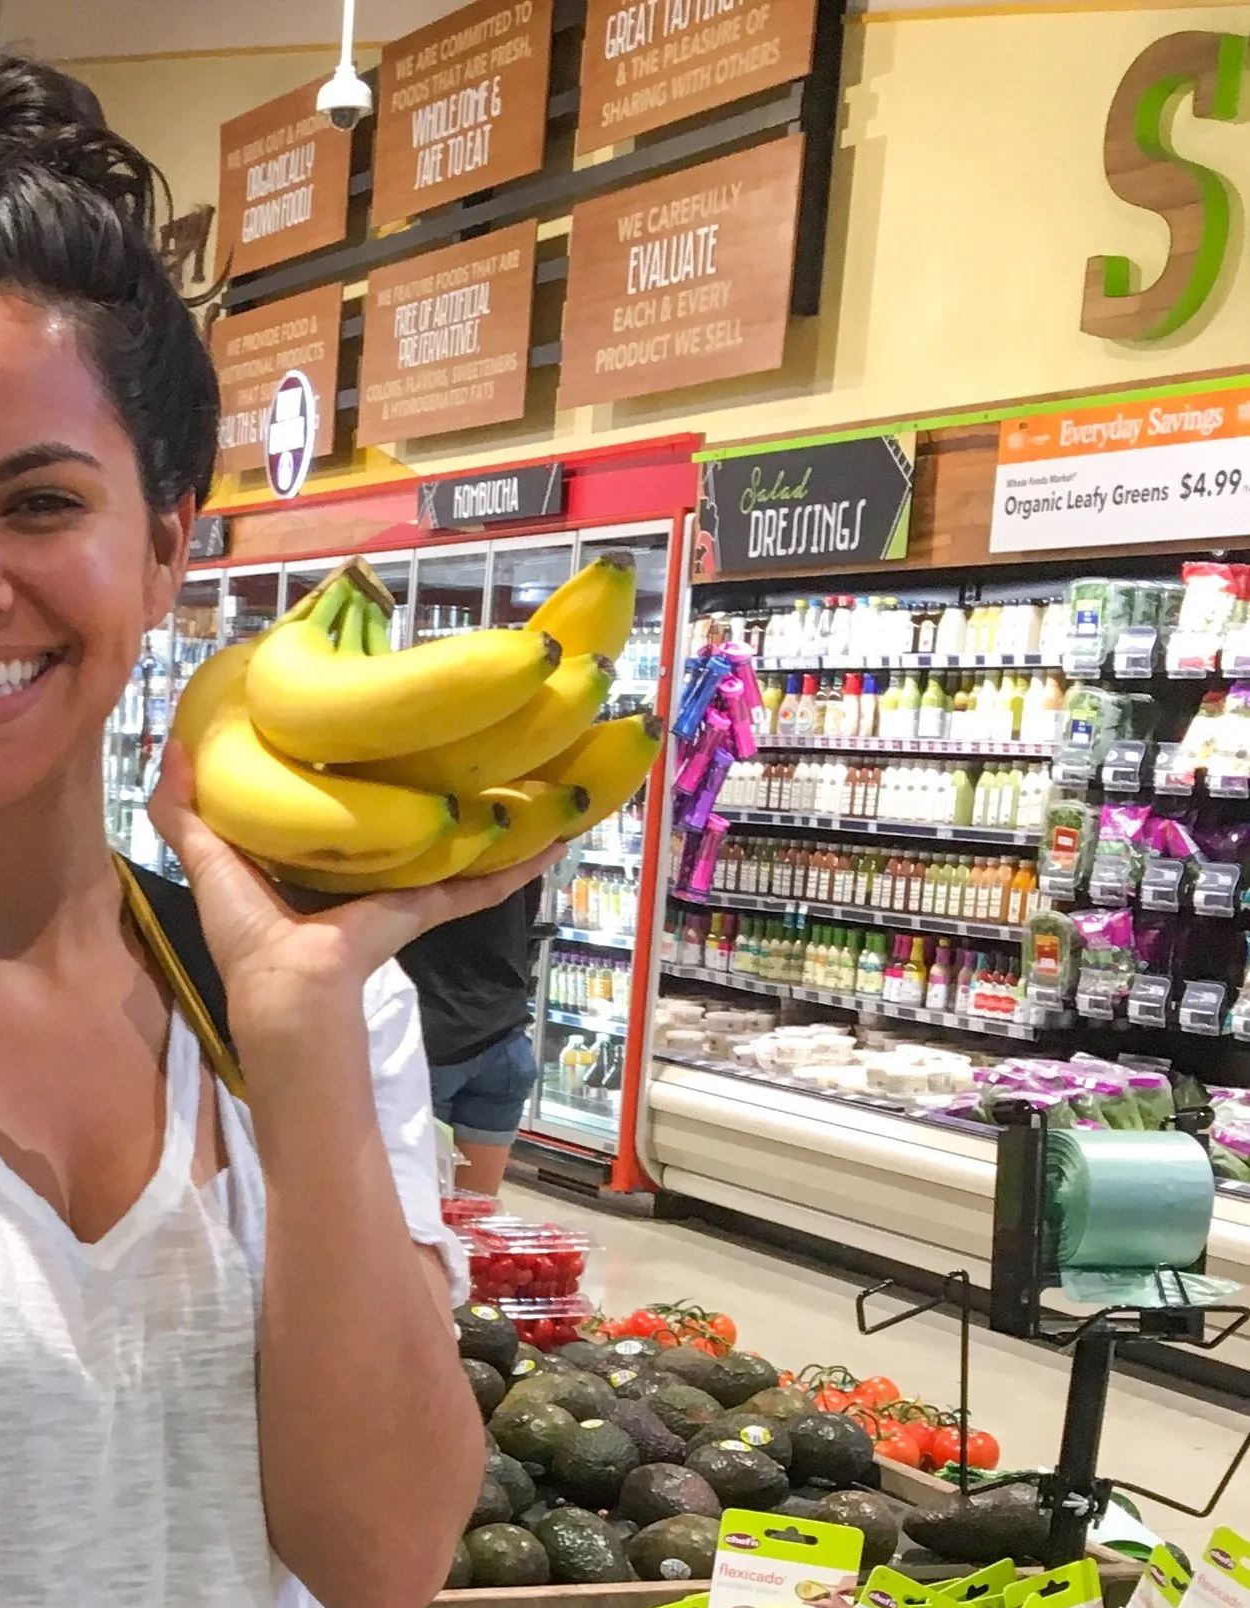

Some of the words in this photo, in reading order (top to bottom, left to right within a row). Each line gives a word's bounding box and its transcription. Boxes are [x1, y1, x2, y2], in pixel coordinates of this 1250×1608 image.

[395, 55, 414, 80] WE
[415, 44, 438, 72] ARE
[440, 8, 512, 60] COMMITTED
[515, 1, 533, 27] TO
[605, 0, 657, 60] GREAT
[615, 61, 627, 87] &
[631, 48, 659, 80] THE
[663, 16, 741, 68] PLEASURE
[746, 4, 771, 35] OF
[390, 78, 430, 113] FOODS
[432, 63, 462, 93] THAT
[463, 52, 488, 82] ARE
[601, 81, 667, 127] SHARING
[671, 66, 710, 99] WITH
[715, 37, 781, 84] OTHERS
[412, 80, 490, 148] WHOLESOME
[414, 143, 444, 191] SAFE
[447, 136, 465, 178] TO
[464, 124, 494, 172] EAT
[618, 212, 642, 242] WE
[647, 180, 743, 234] CAREFULLY
[435, 263, 470, 289] FOODS
[471, 256, 498, 278] THAT
[499, 249, 520, 271] ARE
[627, 224, 720, 295] EVALUATE
[394, 302, 418, 338] FREE
[419, 298, 433, 331] OF
[433, 281, 490, 326] ARTIFICIAL
[613, 302, 655, 332] EACH
[660, 295, 671, 321] &
[677, 280, 732, 318] EVERY
[226, 338, 241, 357] WE
[242, 325, 281, 352] PROVIDE
[281, 317, 306, 341] FOOD
[595, 333, 671, 374] PRODUCT
[674, 327, 701, 356] WE
[705, 318, 743, 351] SELL
[1059, 414, 1143, 448] Everyday
[1146, 404, 1224, 436] Savings
[453, 476, 519, 520] KOMBUCHA
[739, 466, 812, 514] Salad
[1005, 491, 1062, 520] Organic
[1067, 486, 1108, 513] Leafy
[1112, 484, 1169, 506] Greens
[1179, 468, 1242, 500] $4.99
[747, 499, 866, 559] DRESSINGS
[718, 1562, 784, 1586] flexicado
